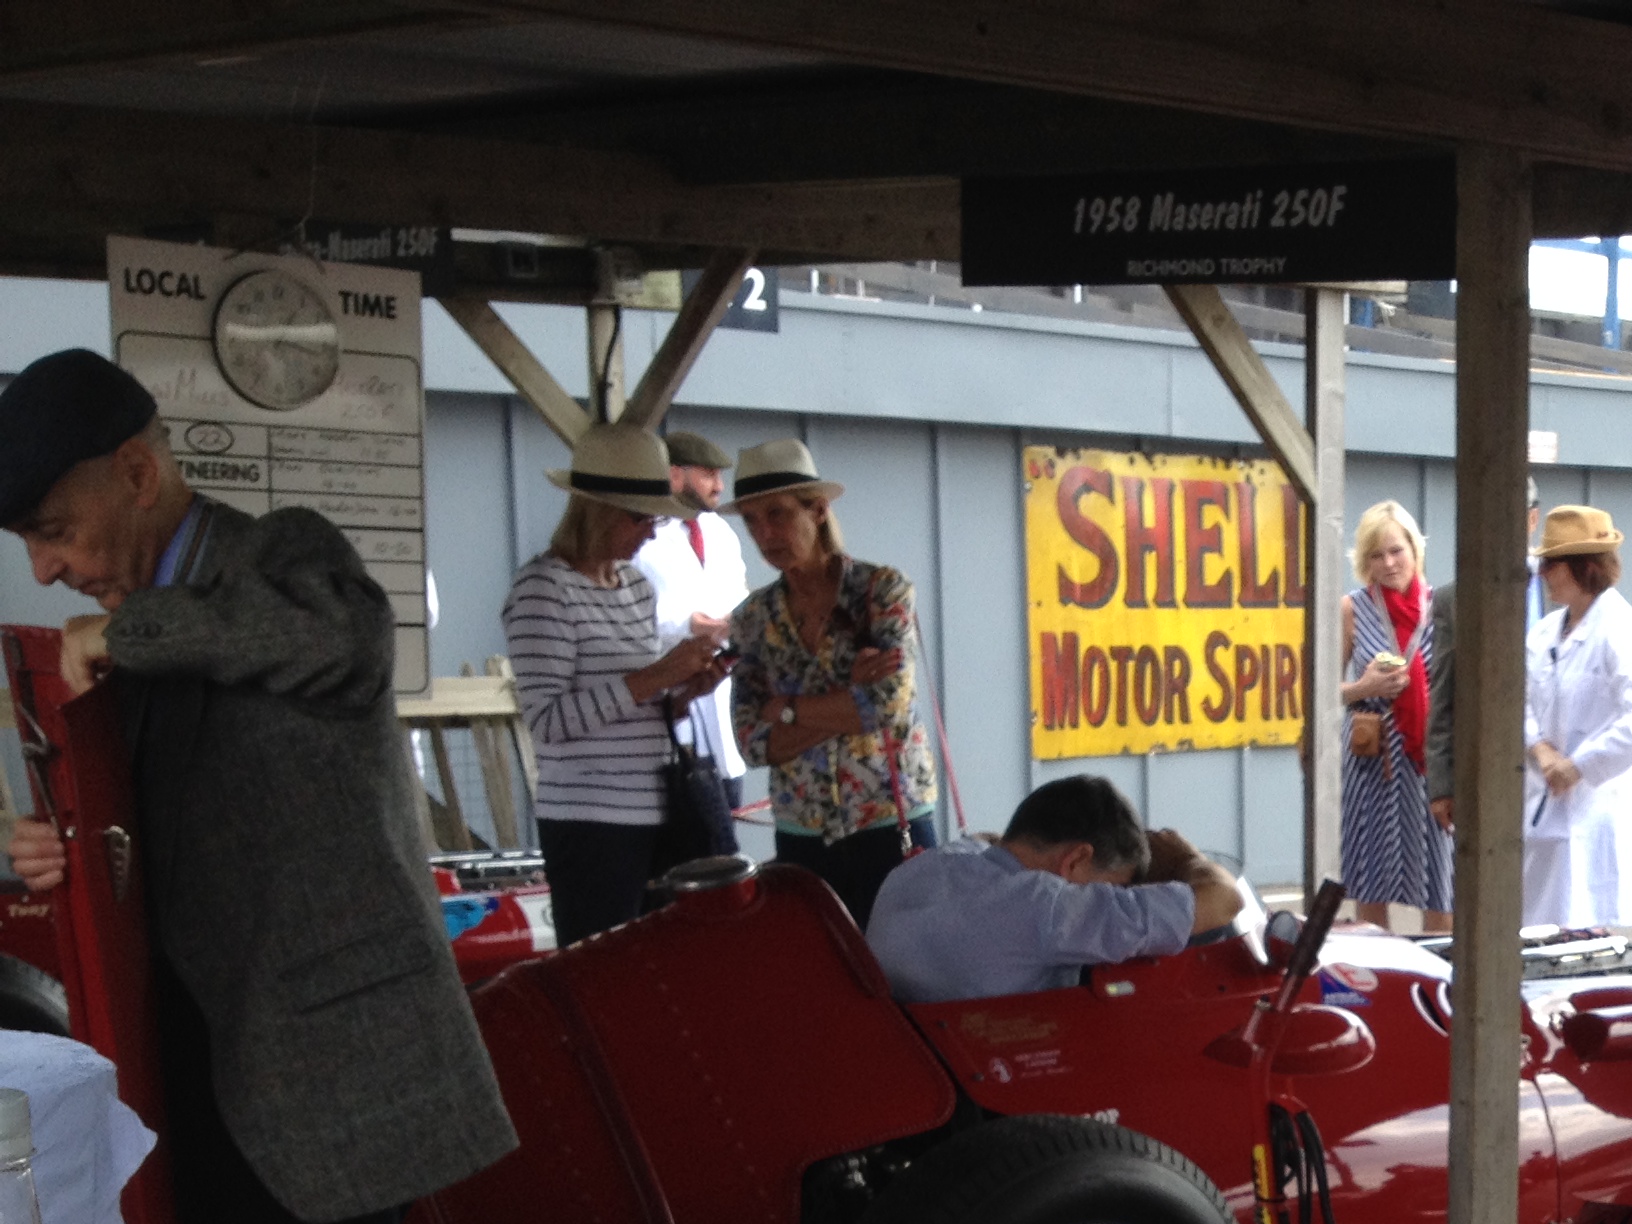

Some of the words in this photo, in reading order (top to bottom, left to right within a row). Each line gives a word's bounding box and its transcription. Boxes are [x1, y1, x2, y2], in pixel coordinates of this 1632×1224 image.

[1073, 196, 1142, 234] 1958
[1148, 189, 1264, 232] Maserati
[1268, 185, 1348, 229] 250F
[741, 266, 768, 312] 2
[1125, 259, 1216, 278] RICHMOND
[1220, 255, 1288, 276] TROPHY
[123, 266, 207, 301] LOCAL
[338, 289, 399, 321] TIME
[178, 460, 260, 483] INEERING
[1056, 465, 1306, 611] SHELL
[1040, 630, 1192, 732] MOTOR
[1201, 629, 1304, 725] SPIR
